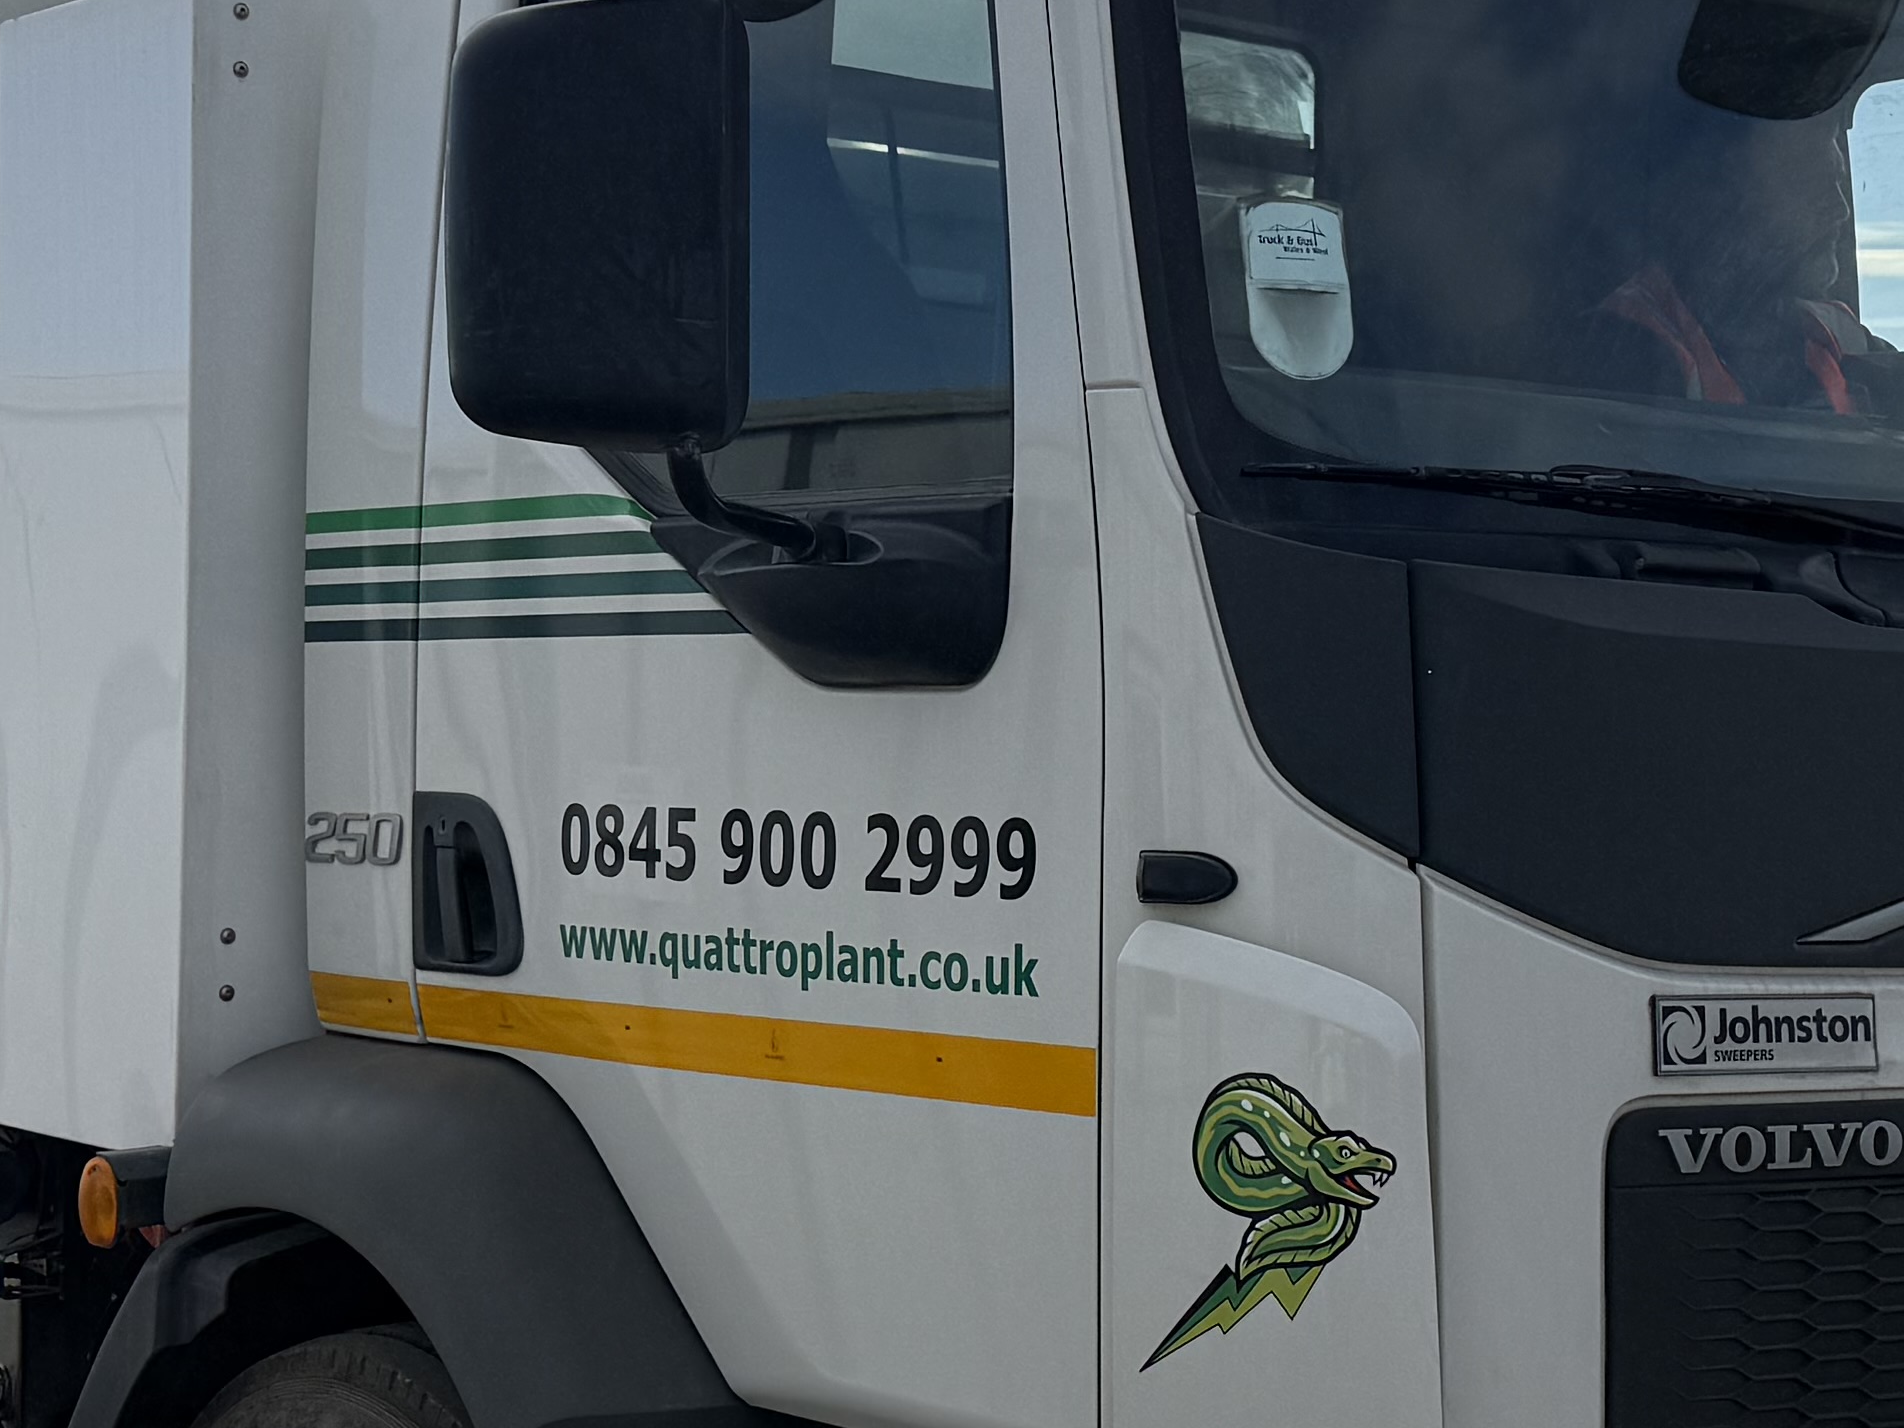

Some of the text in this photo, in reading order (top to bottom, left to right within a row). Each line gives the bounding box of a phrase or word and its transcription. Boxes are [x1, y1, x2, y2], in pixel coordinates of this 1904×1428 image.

[304, 811, 403, 867] 250
[559, 802, 1038, 901] 0845 900 2999
[559, 922, 1040, 998] www.quattroplant.co.uk
[1714, 1005, 1871, 1045] Johnston
[1714, 1049, 1774, 1062] SWEEPERS
[1658, 1120, 1903, 1174] VOLVO
